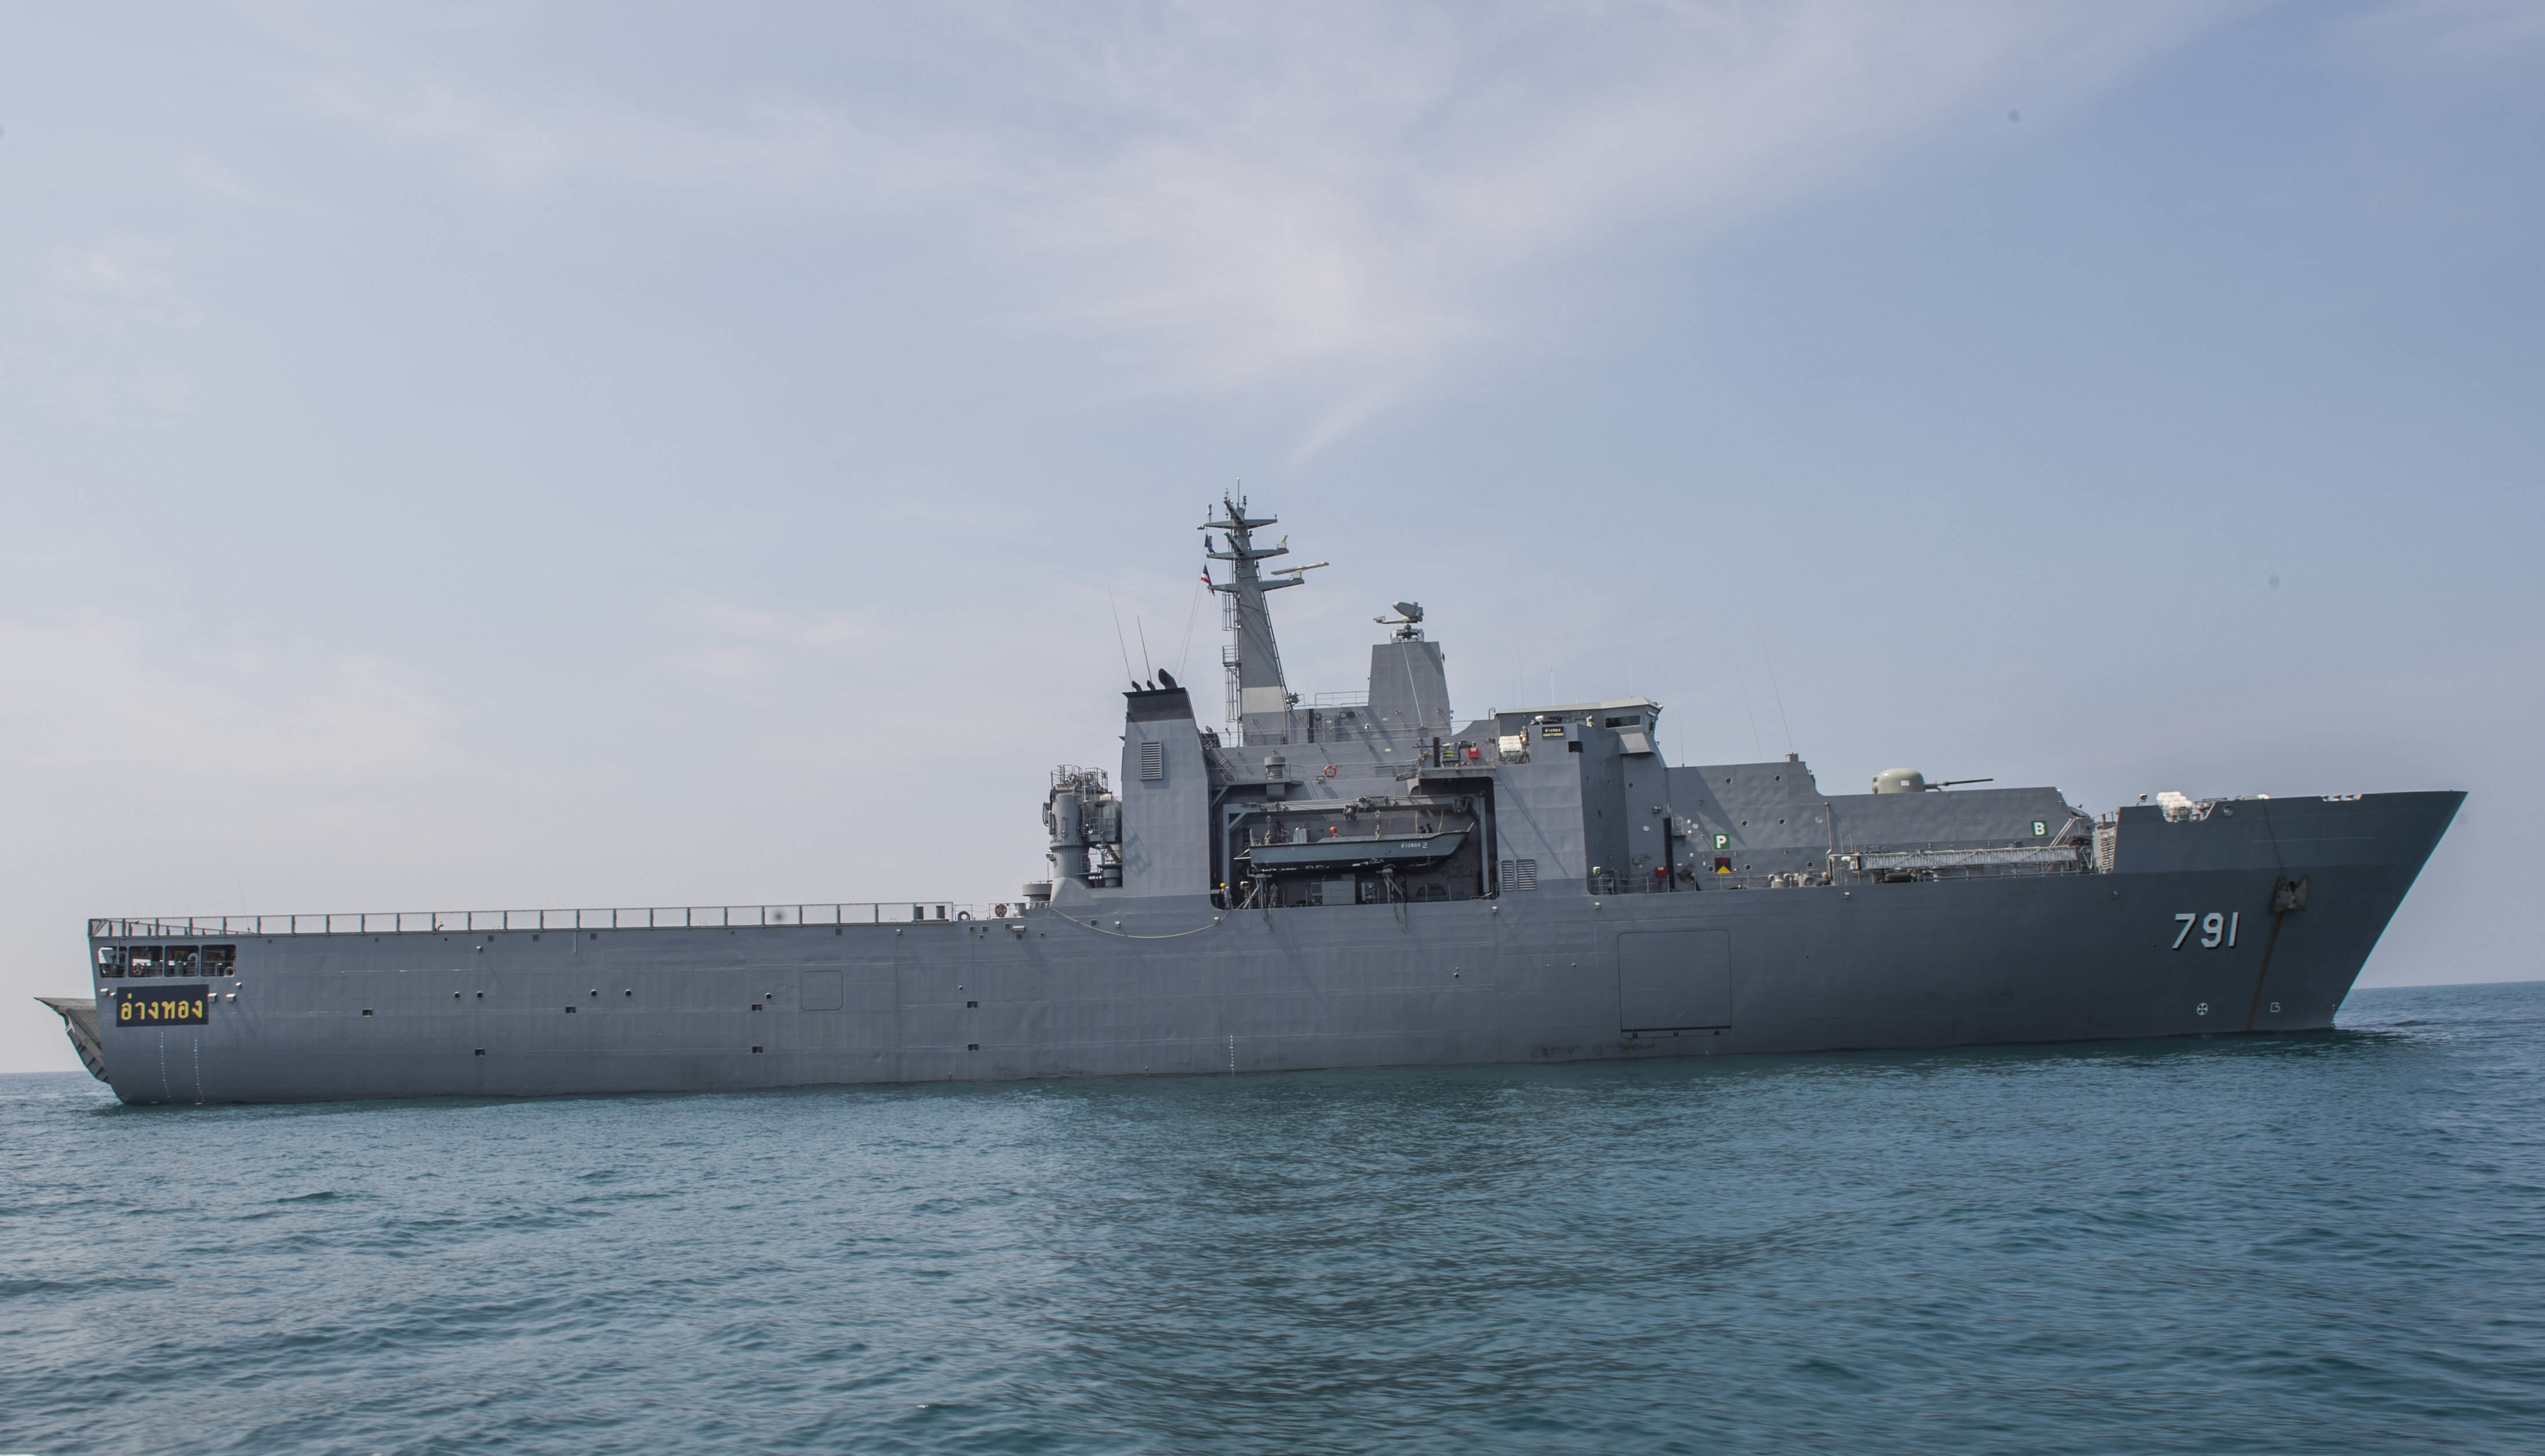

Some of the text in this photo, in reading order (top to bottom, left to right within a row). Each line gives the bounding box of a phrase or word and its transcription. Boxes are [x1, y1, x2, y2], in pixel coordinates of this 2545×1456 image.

[2034, 822, 2045, 835] B
[1716, 835, 1727, 849] P
[2172, 912, 2239, 948] 791
[121, 992, 203, 1020] อ่างทอง
